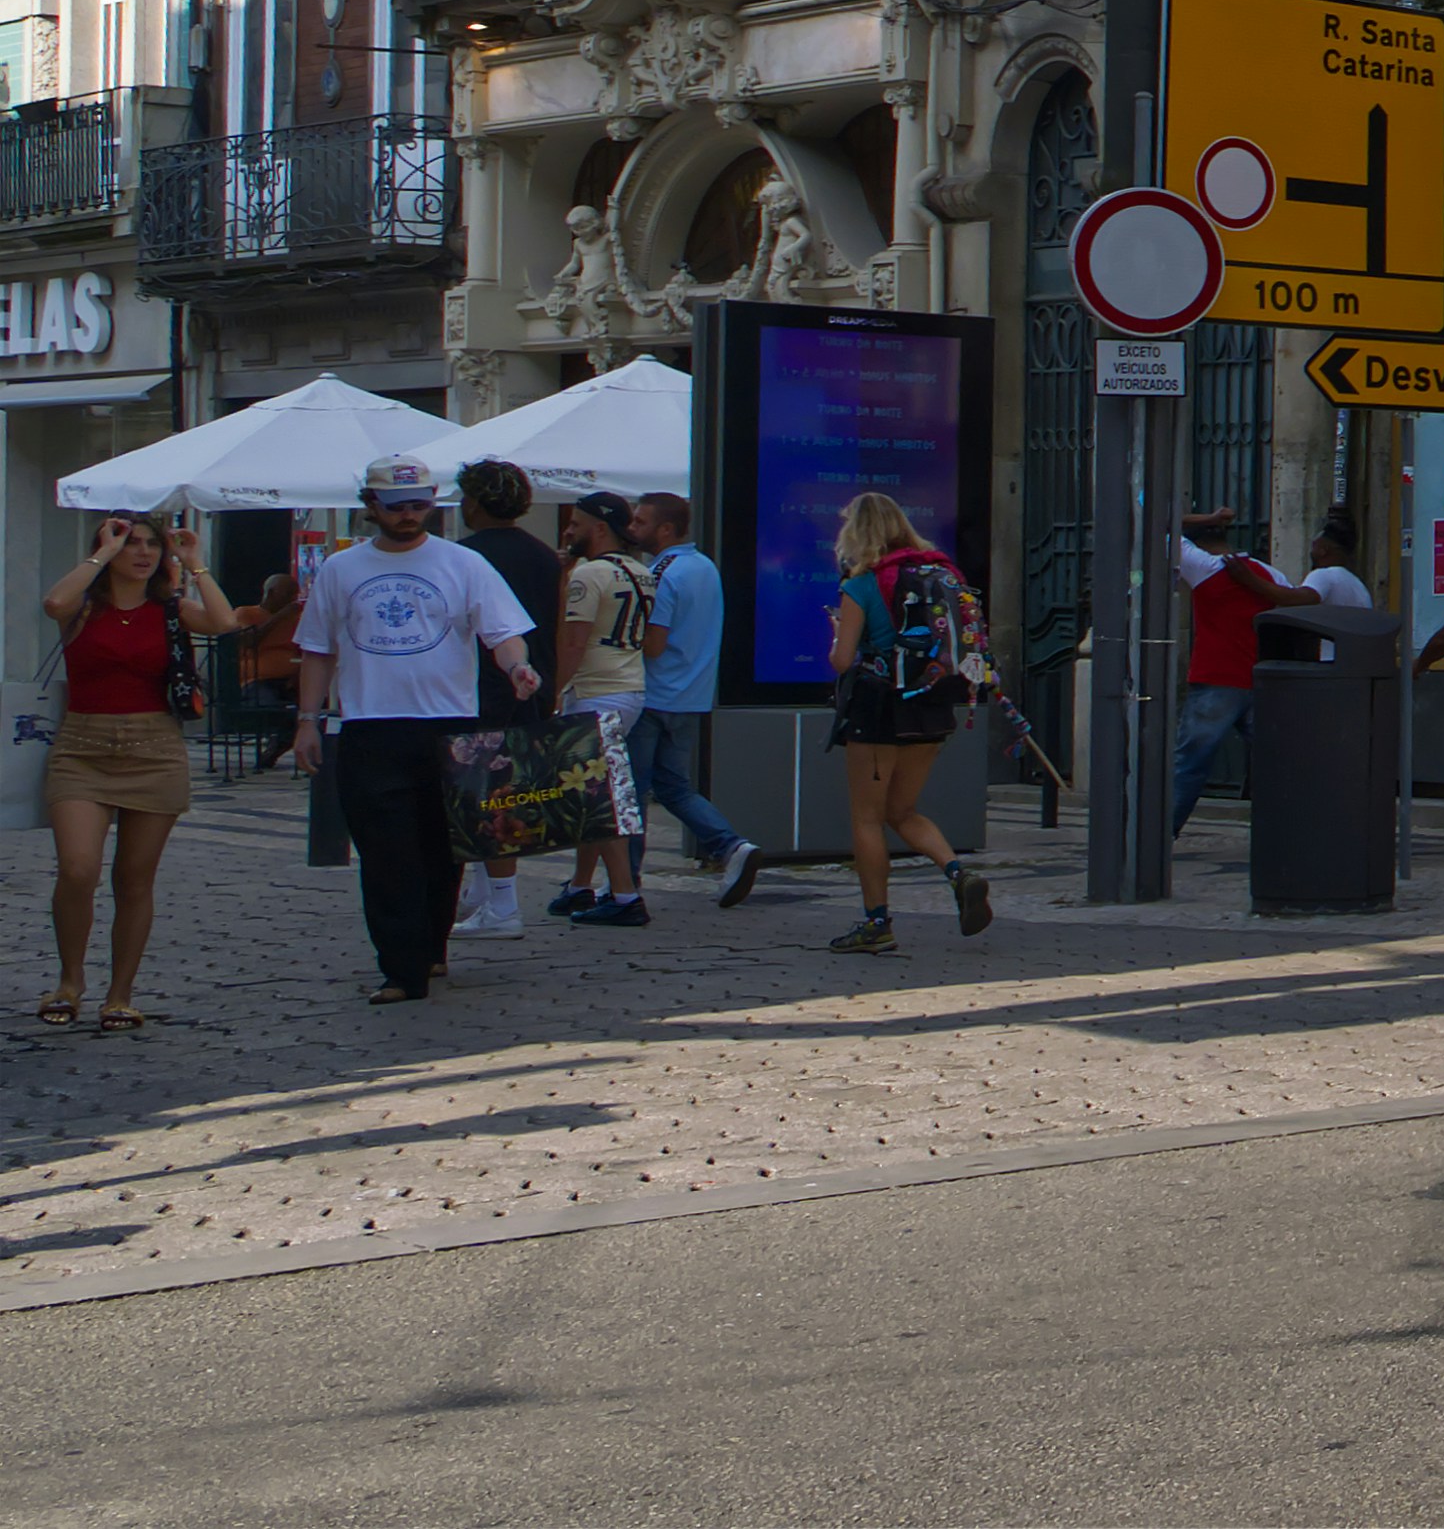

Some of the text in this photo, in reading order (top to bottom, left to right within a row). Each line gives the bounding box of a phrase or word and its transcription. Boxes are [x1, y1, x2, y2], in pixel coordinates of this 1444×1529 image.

[1324, 14, 1436, 53] R. Santa
[1323, 49, 1435, 87] Catarina
[1254, 281, 1360, 315] 100 m
[0, 271, 113, 356] LAS
[1118, 346, 1161, 358] EXCETO
[1113, 360, 1167, 375] VEÍCULOS
[1103, 378, 1179, 391] AUTORIZADOS
[360, 583, 432, 601] HOTEL DU CAP
[480, 787, 563, 812] FALCONERI
